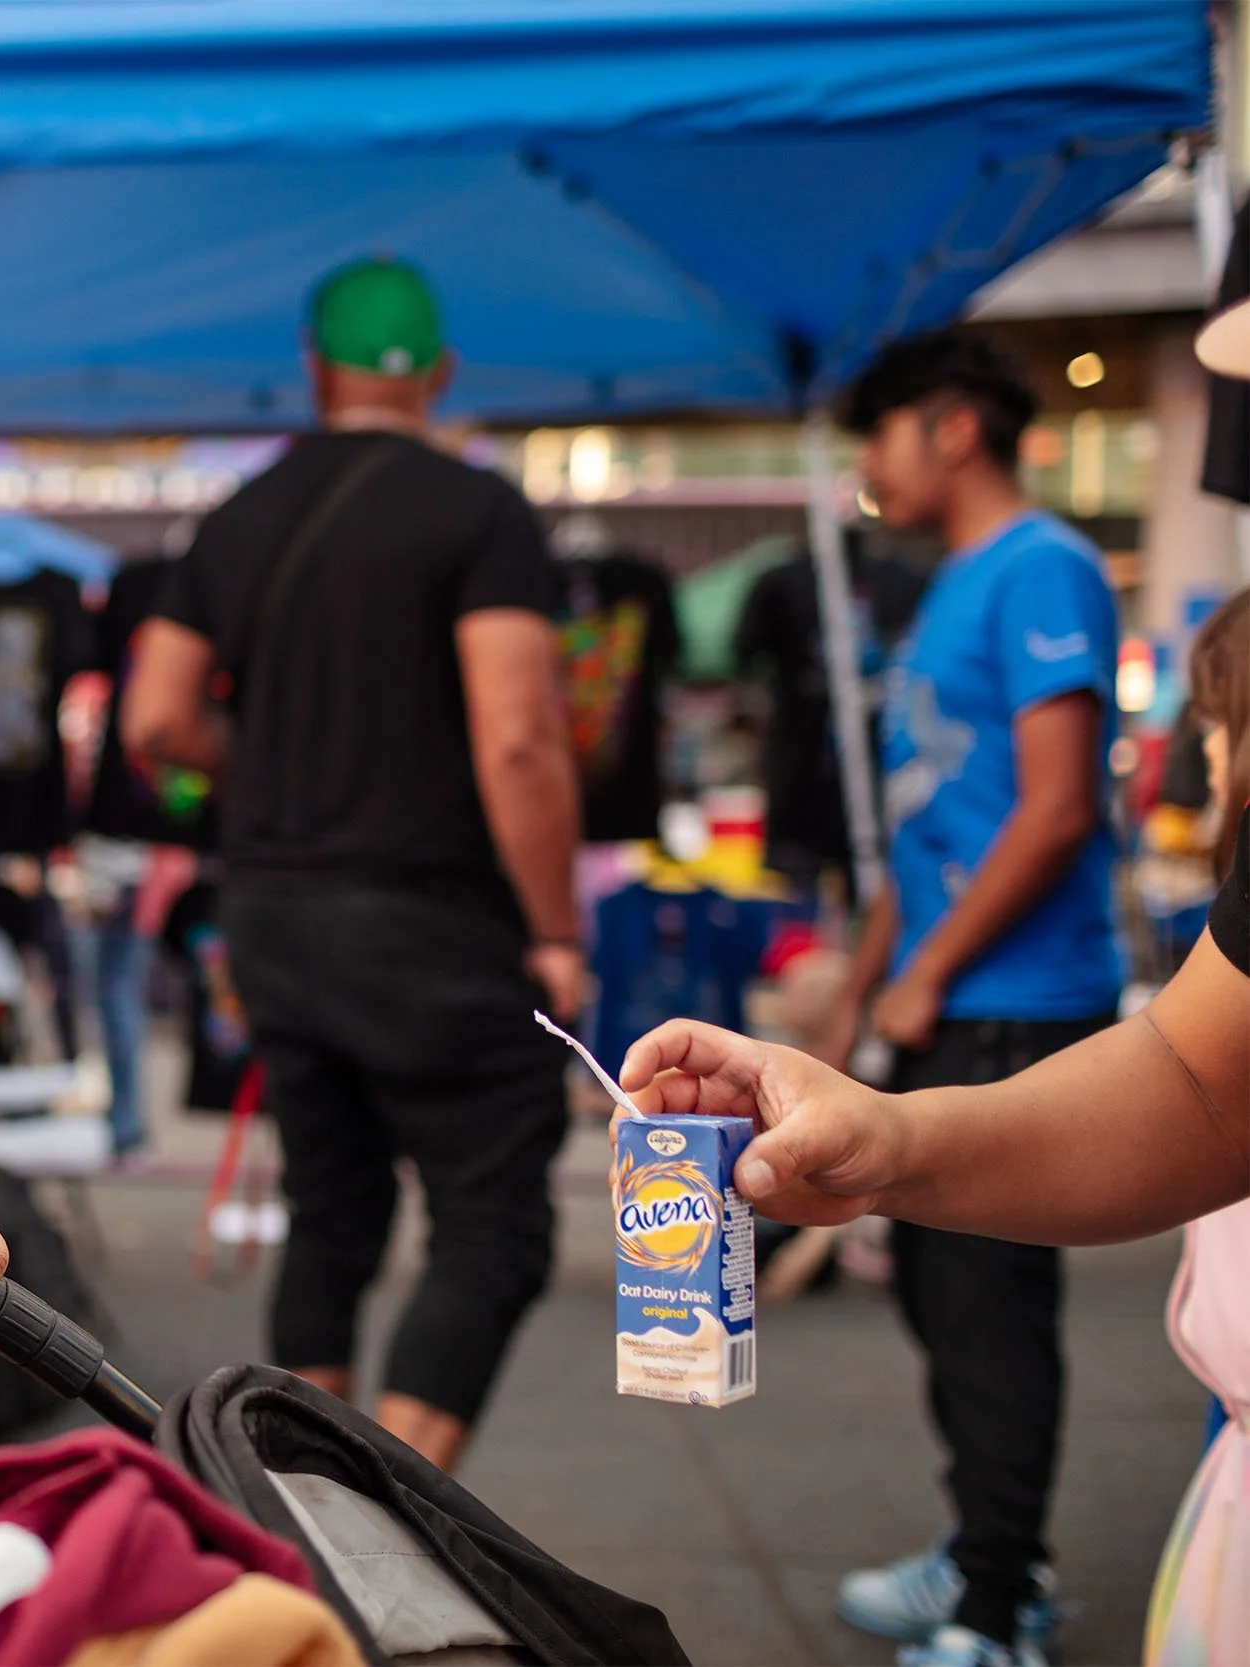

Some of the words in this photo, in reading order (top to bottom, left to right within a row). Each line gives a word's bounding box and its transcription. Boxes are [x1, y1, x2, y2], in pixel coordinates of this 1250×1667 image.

[620, 1196, 714, 1232] avena
[619, 1283, 641, 1297] Oat
[643, 1285, 678, 1303] Dairy
[680, 1288, 712, 1304] Drink
[642, 1306, 688, 1320] original
